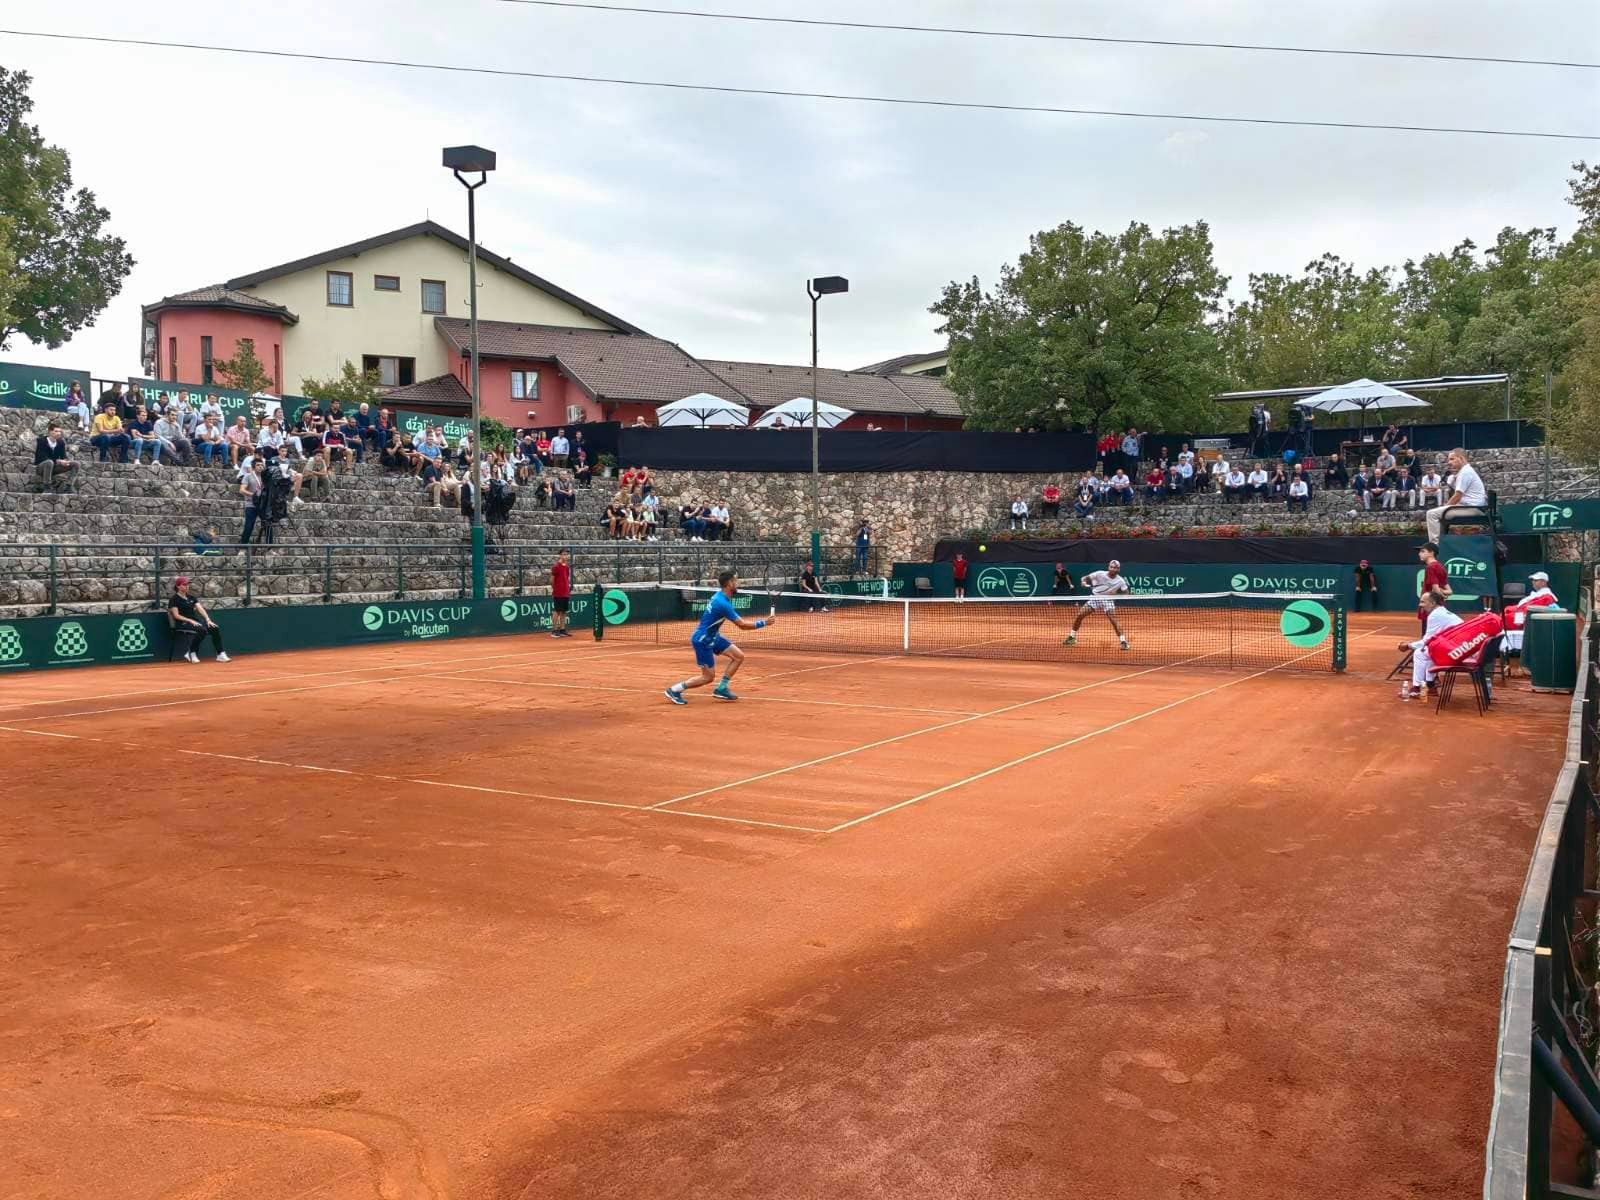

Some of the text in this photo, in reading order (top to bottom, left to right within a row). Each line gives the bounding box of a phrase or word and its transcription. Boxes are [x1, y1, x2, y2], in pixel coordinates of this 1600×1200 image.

[218, 396, 245, 409] CUP
[1532, 511, 1560, 527] ITF
[1447, 563, 1474, 576] ITF
[856, 582, 870, 593] THE
[892, 579, 905, 590] CUP
[981, 580, 998, 590] ITF
[1154, 576, 1185, 587] CUP
[1253, 577, 1336, 589] DAVIS CUP
[387, 606, 471, 624] DAVIS CUP
[411, 624, 450, 637] Rakuten
[1447, 632, 1488, 660] Wilson
